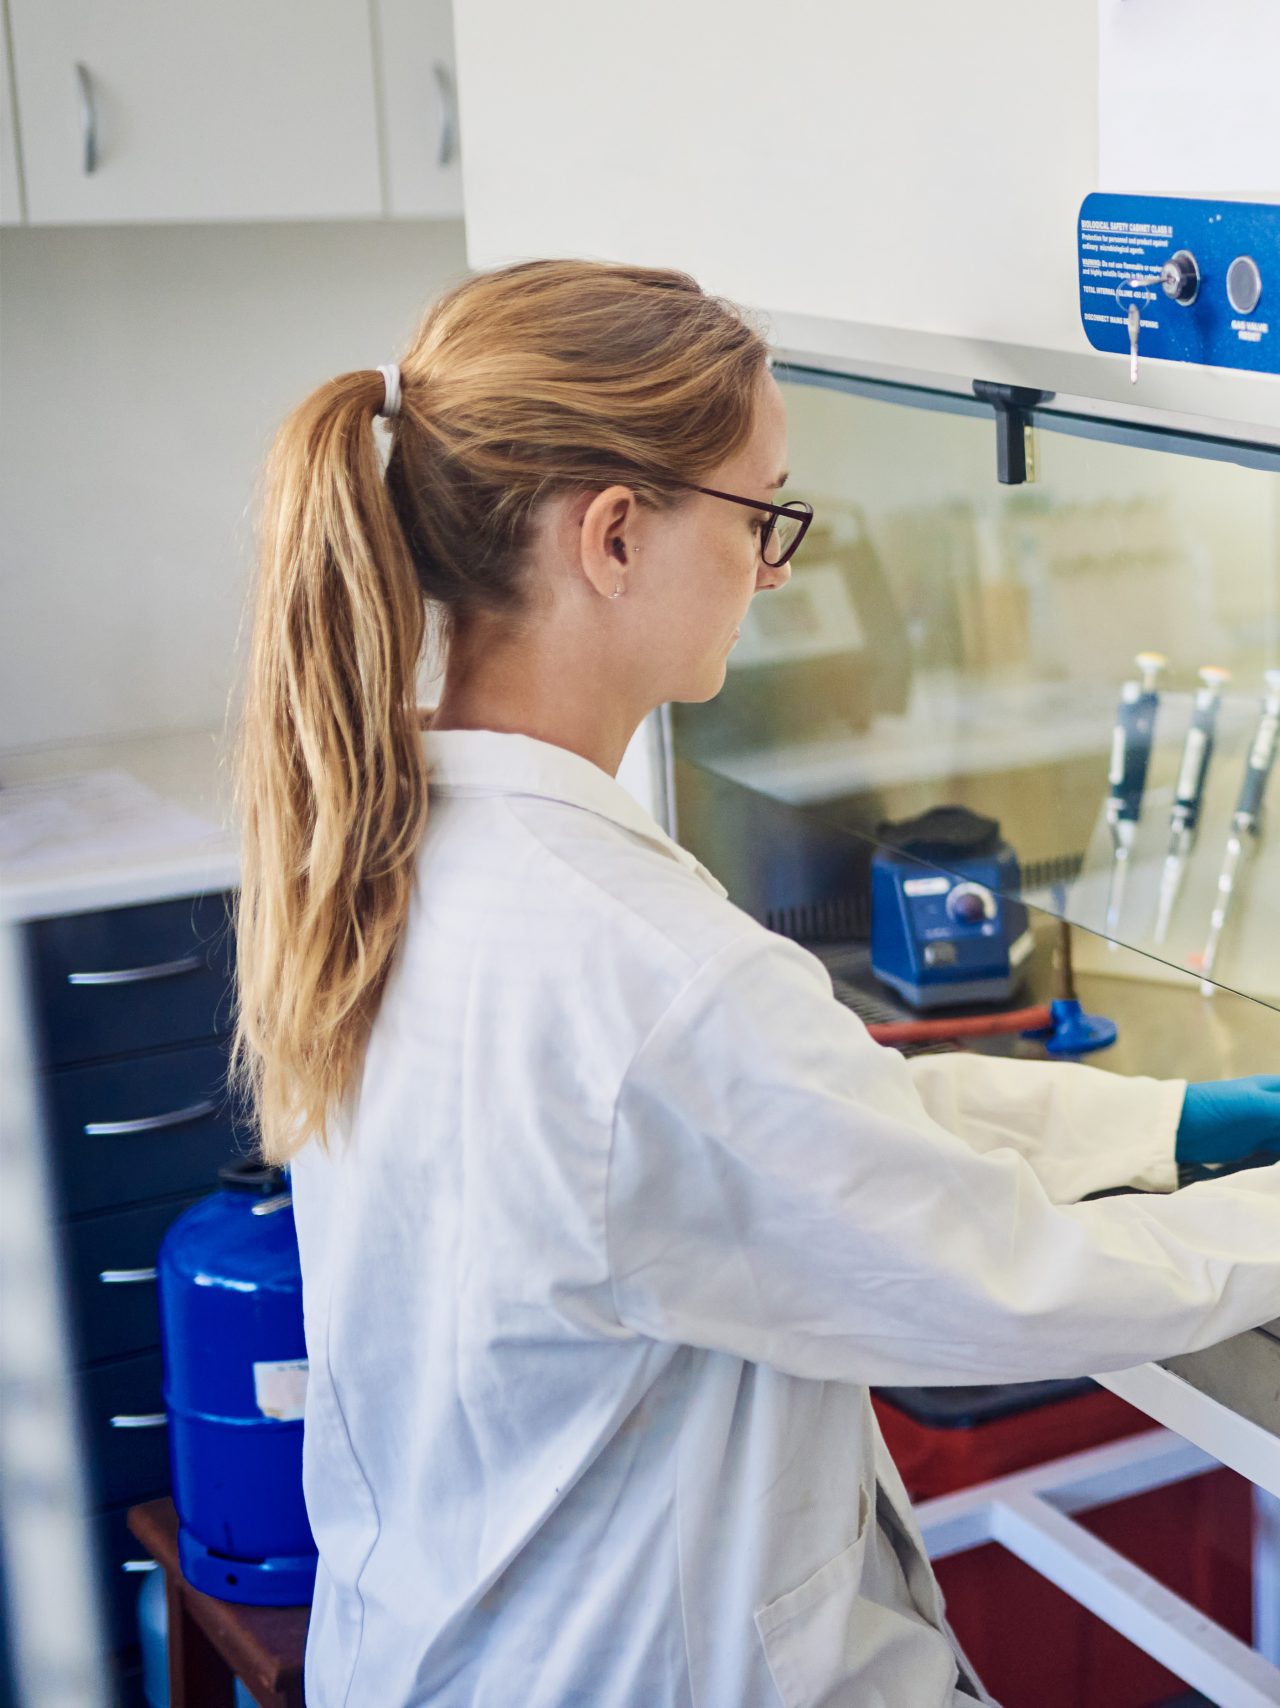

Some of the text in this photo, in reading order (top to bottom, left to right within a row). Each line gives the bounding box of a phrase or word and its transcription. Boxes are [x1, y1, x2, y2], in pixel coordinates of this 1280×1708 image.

[1081, 220, 1109, 230] BIOLOGICAL
[1110, 222, 1128, 231] SAFETY
[1129, 223, 1150, 233] CABINET
[1151, 225, 1166, 235] CLASS
[1083, 285, 1097, 294] TOTAL
[1084, 313, 1109, 323] DISCONNECT
